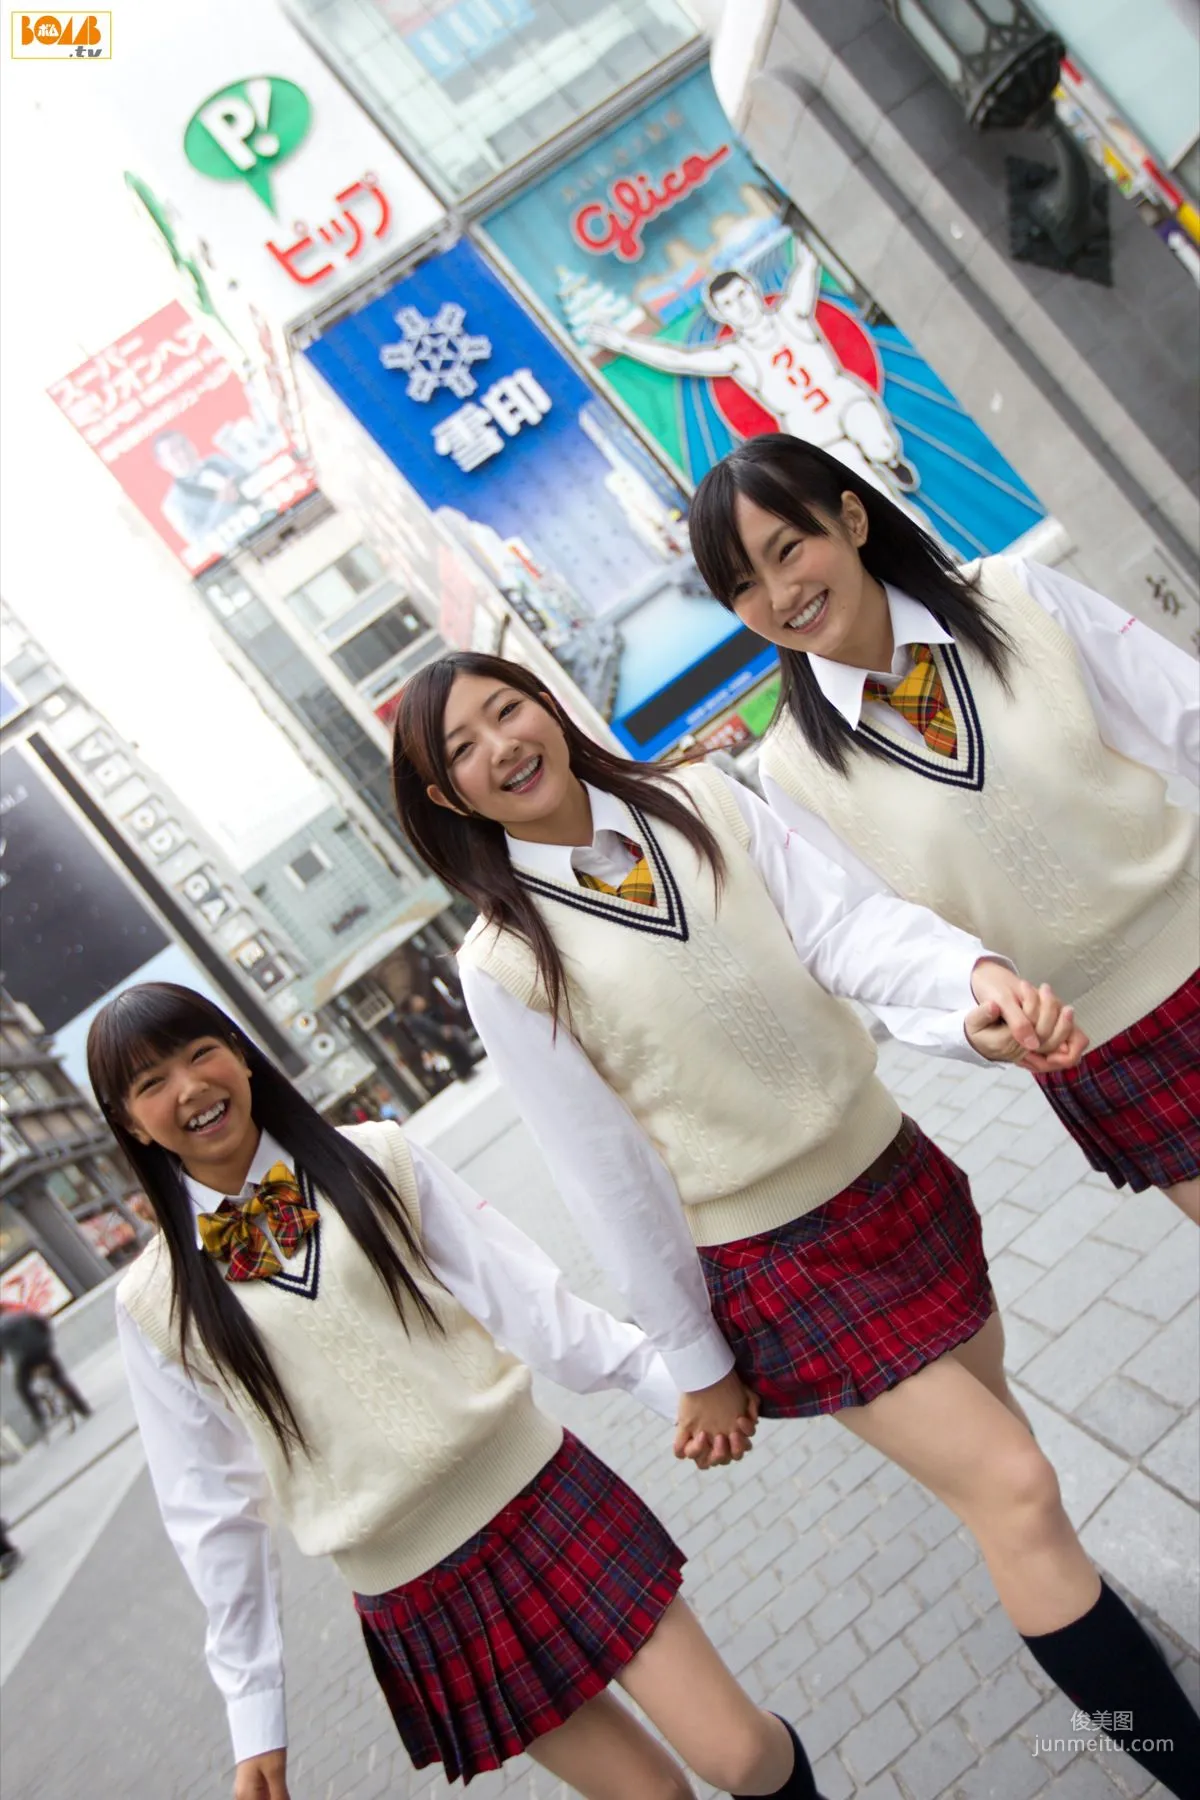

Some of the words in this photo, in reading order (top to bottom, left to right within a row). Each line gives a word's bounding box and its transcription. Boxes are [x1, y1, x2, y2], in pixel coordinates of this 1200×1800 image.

[264, 171, 391, 288] ピップ
[430, 367, 553, 473] 雪印
